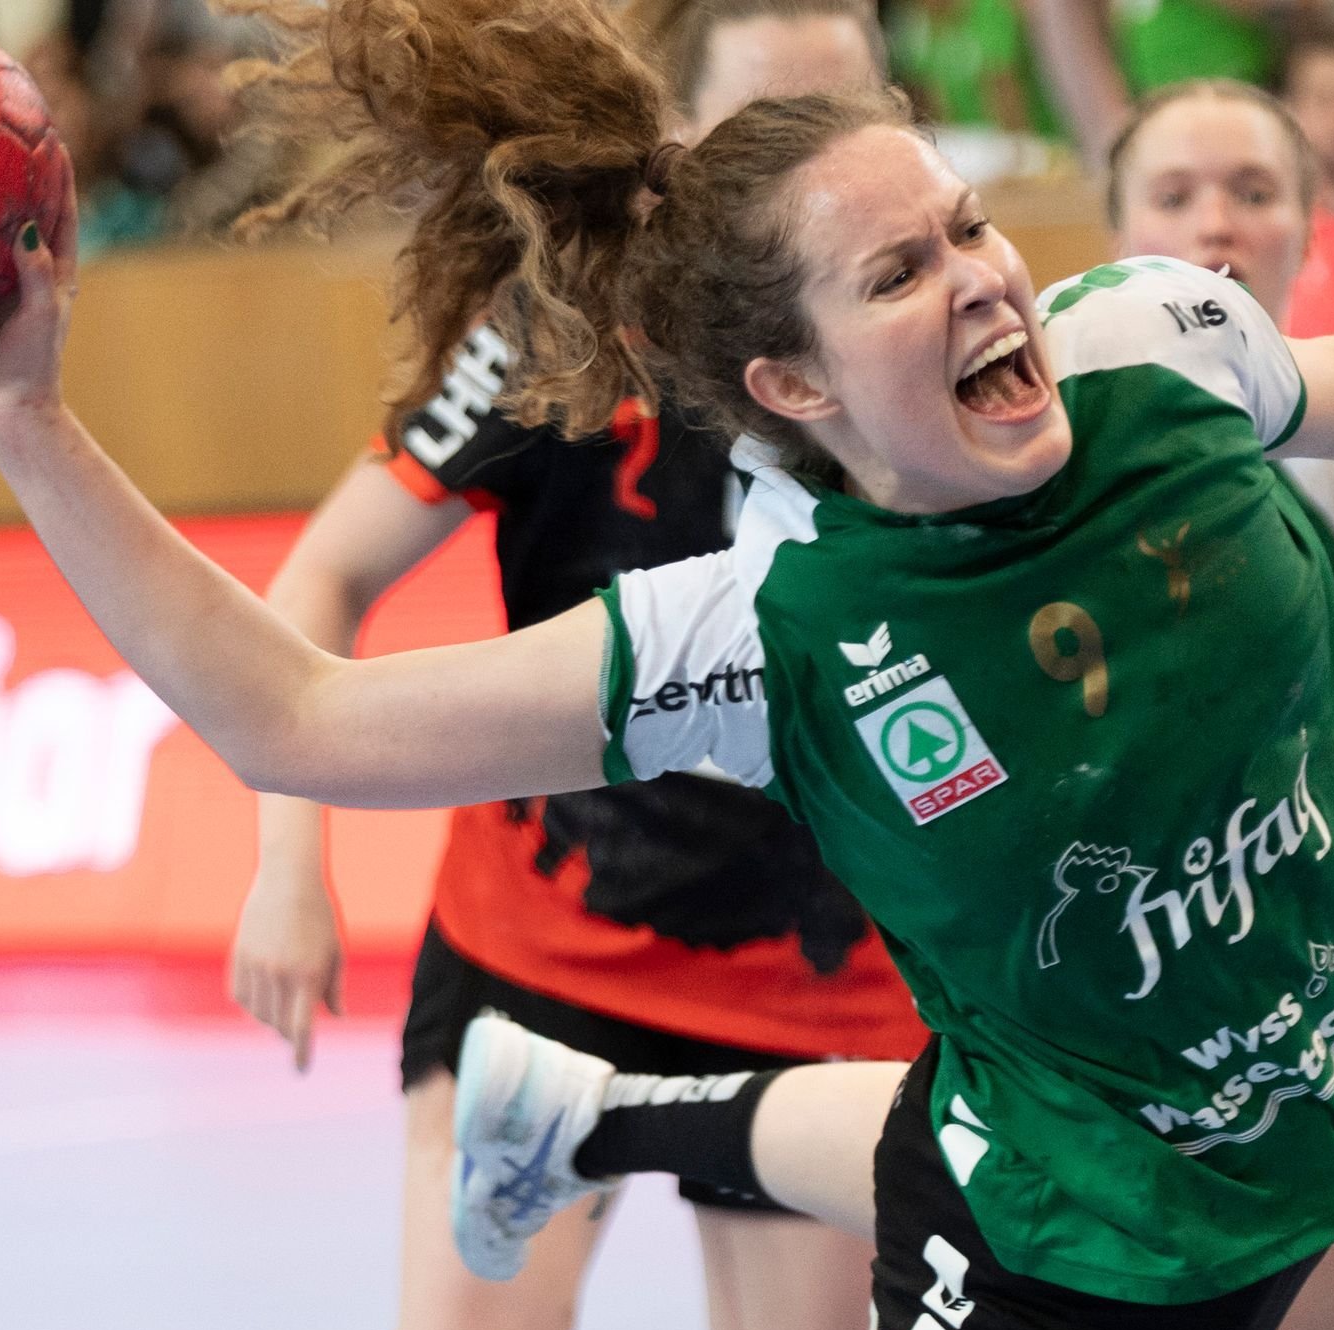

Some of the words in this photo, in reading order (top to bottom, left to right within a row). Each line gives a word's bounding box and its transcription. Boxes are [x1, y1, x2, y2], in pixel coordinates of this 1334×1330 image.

[844, 653, 931, 707] erima
[1028, 601, 1109, 718] 9
[916, 763, 997, 815] SPAR
